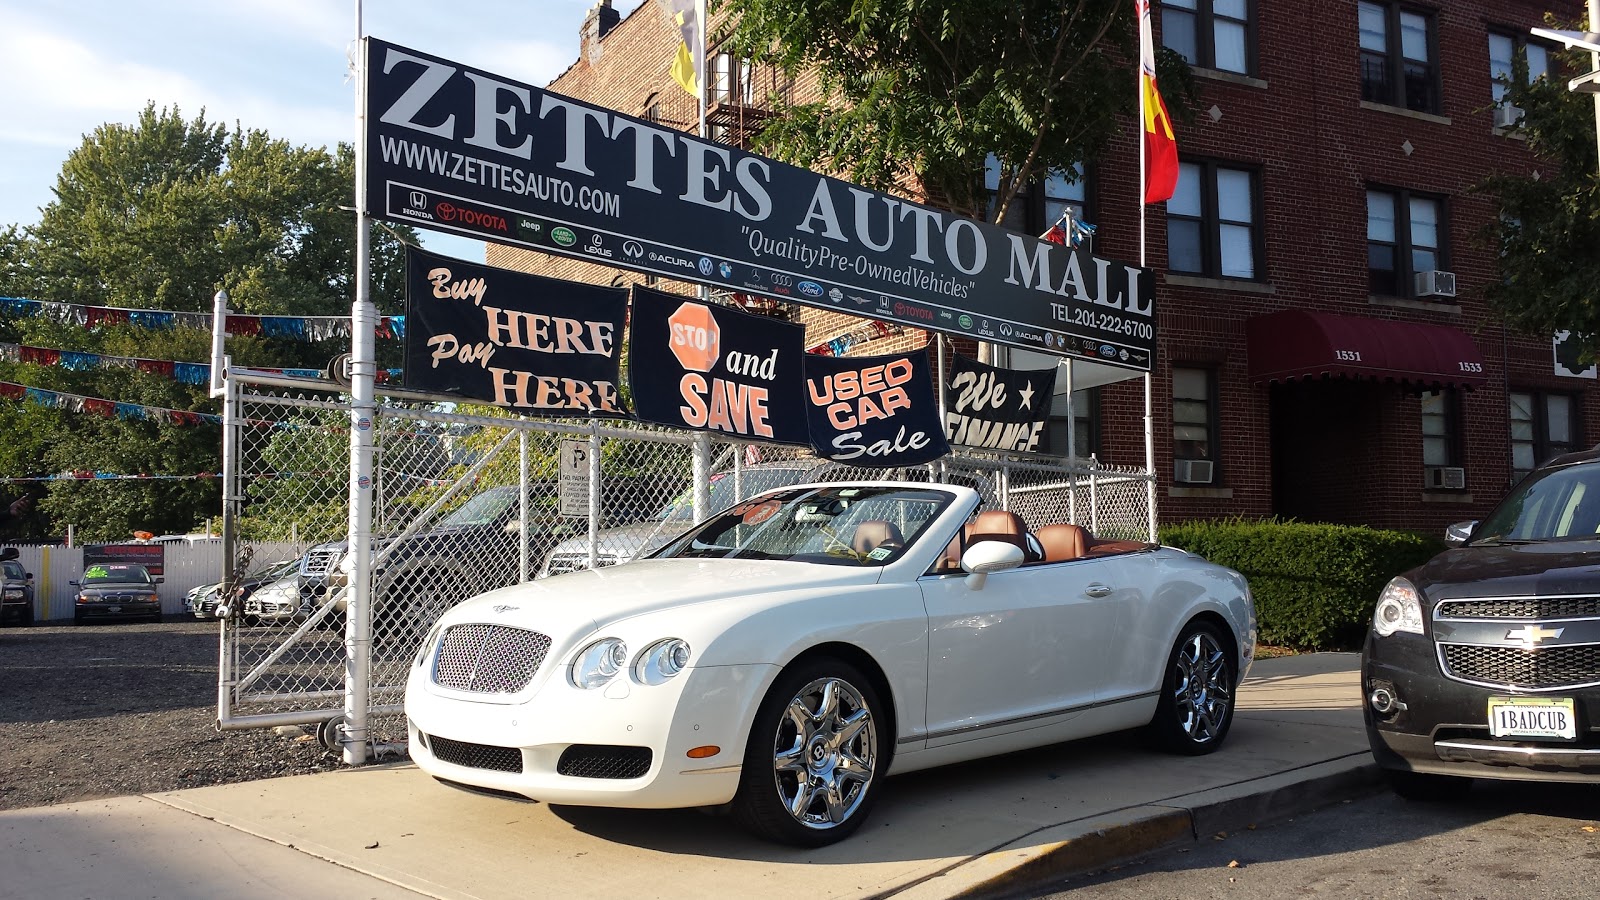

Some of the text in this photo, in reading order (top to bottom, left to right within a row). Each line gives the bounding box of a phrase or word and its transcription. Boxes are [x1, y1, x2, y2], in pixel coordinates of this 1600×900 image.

[380, 134, 620, 218] WWW.ZETTESAUTO.COM
[380, 47, 1153, 317] ZETTES AUTO MALL
[402, 207, 433, 220] HONDA
[457, 208, 507, 231] TOYOTA
[521, 219, 541, 231] Jeep
[584, 245, 612, 258] LEXUS
[657, 255, 695, 269] ACURA
[427, 267, 488, 307] Buy
[773, 286, 790, 295] Audi
[802, 284, 819, 296] Ford
[906, 305, 933, 320] TOYOTA
[482, 305, 615, 358] HERE
[673, 322, 717, 352] STOP
[1020, 332, 1043, 342] ACURA
[427, 333, 496, 369] Pay
[725, 349, 779, 381] and
[1335, 350, 1362, 362] 1531
[807, 358, 914, 406] USED
[1458, 361, 1482, 373] 1533
[488, 366, 626, 415] HERE
[679, 372, 775, 438] SAVE
[952, 371, 1007, 414] We
[826, 386, 911, 431] CAR
[829, 425, 931, 460] Sale
[947, 412, 1044, 452] FINANCE
[1500, 710, 1567, 730] 1BADCUB
